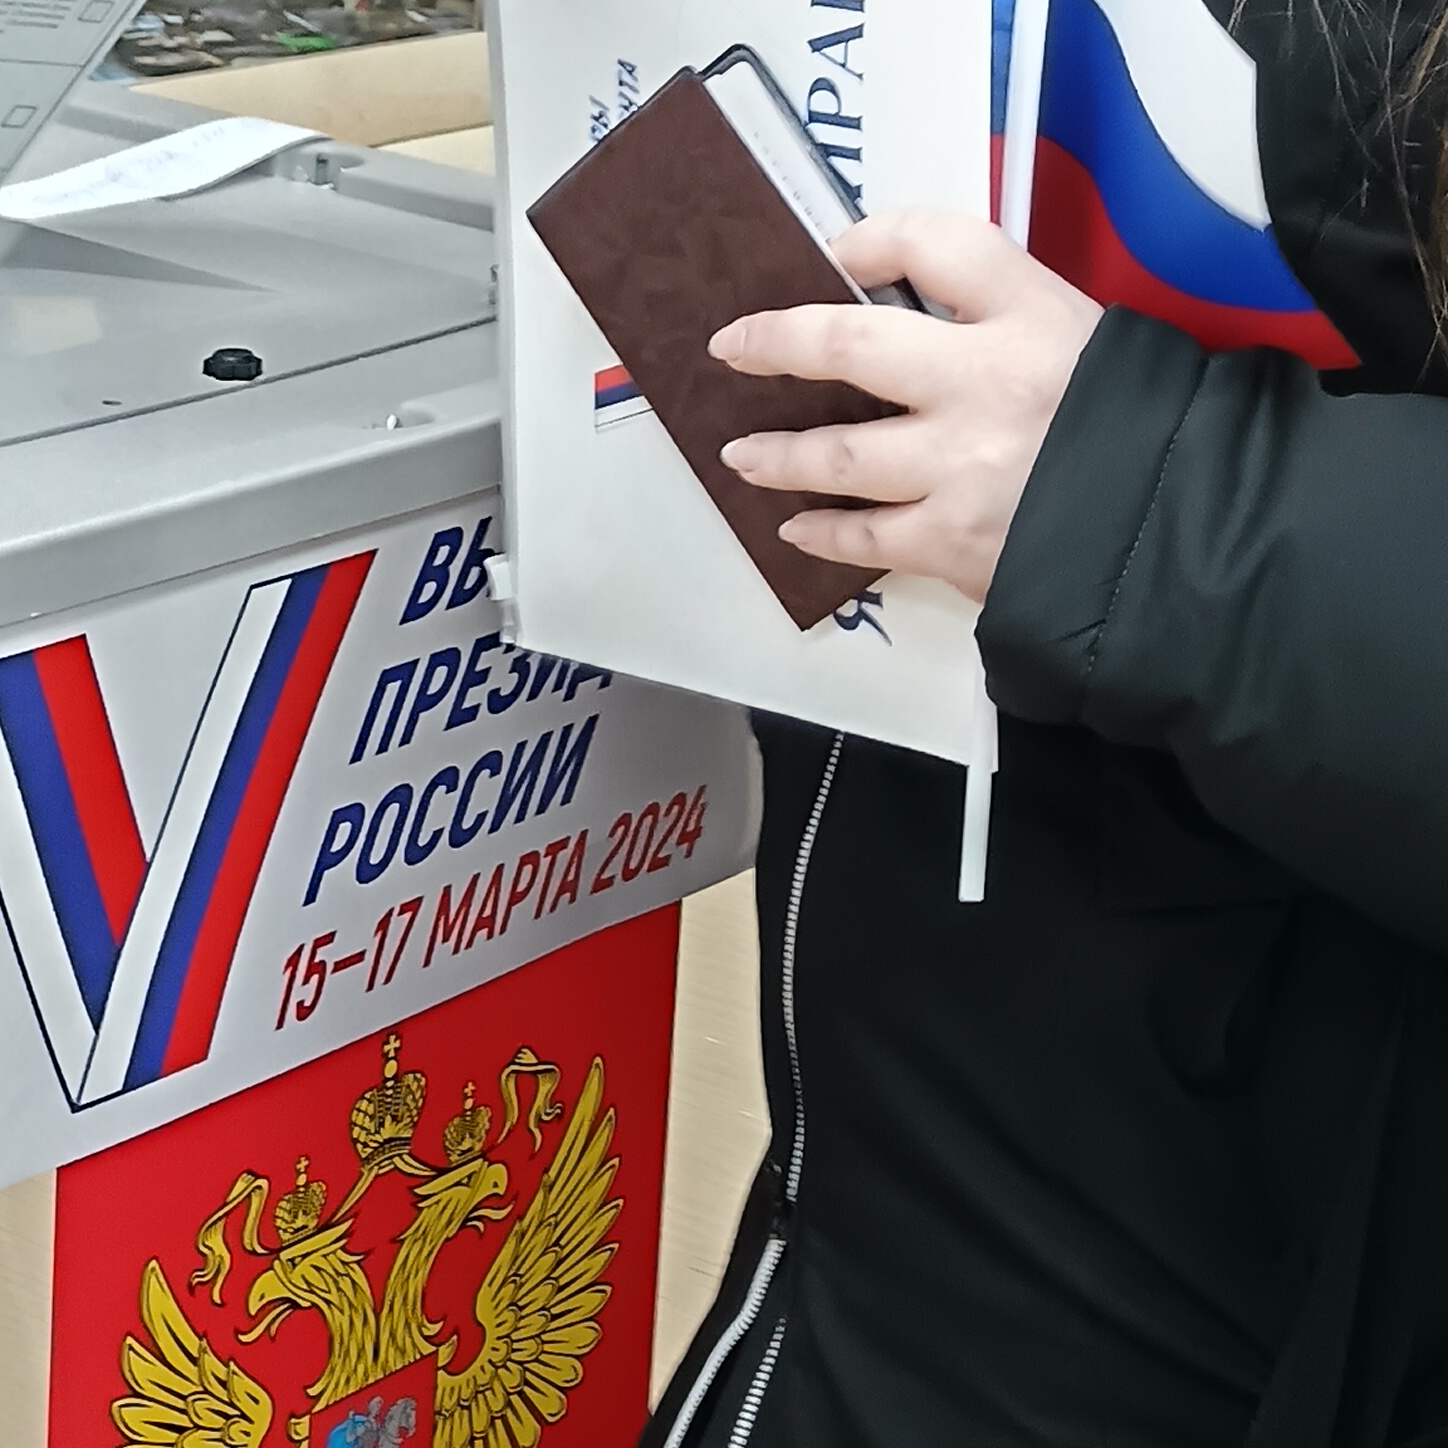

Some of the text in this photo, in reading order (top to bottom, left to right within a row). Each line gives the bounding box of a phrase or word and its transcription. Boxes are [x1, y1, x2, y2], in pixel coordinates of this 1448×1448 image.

[302, 713, 601, 907] РОССИИ
[422, 828, 590, 970] МАРТА
[590, 784, 709, 897] 2024
